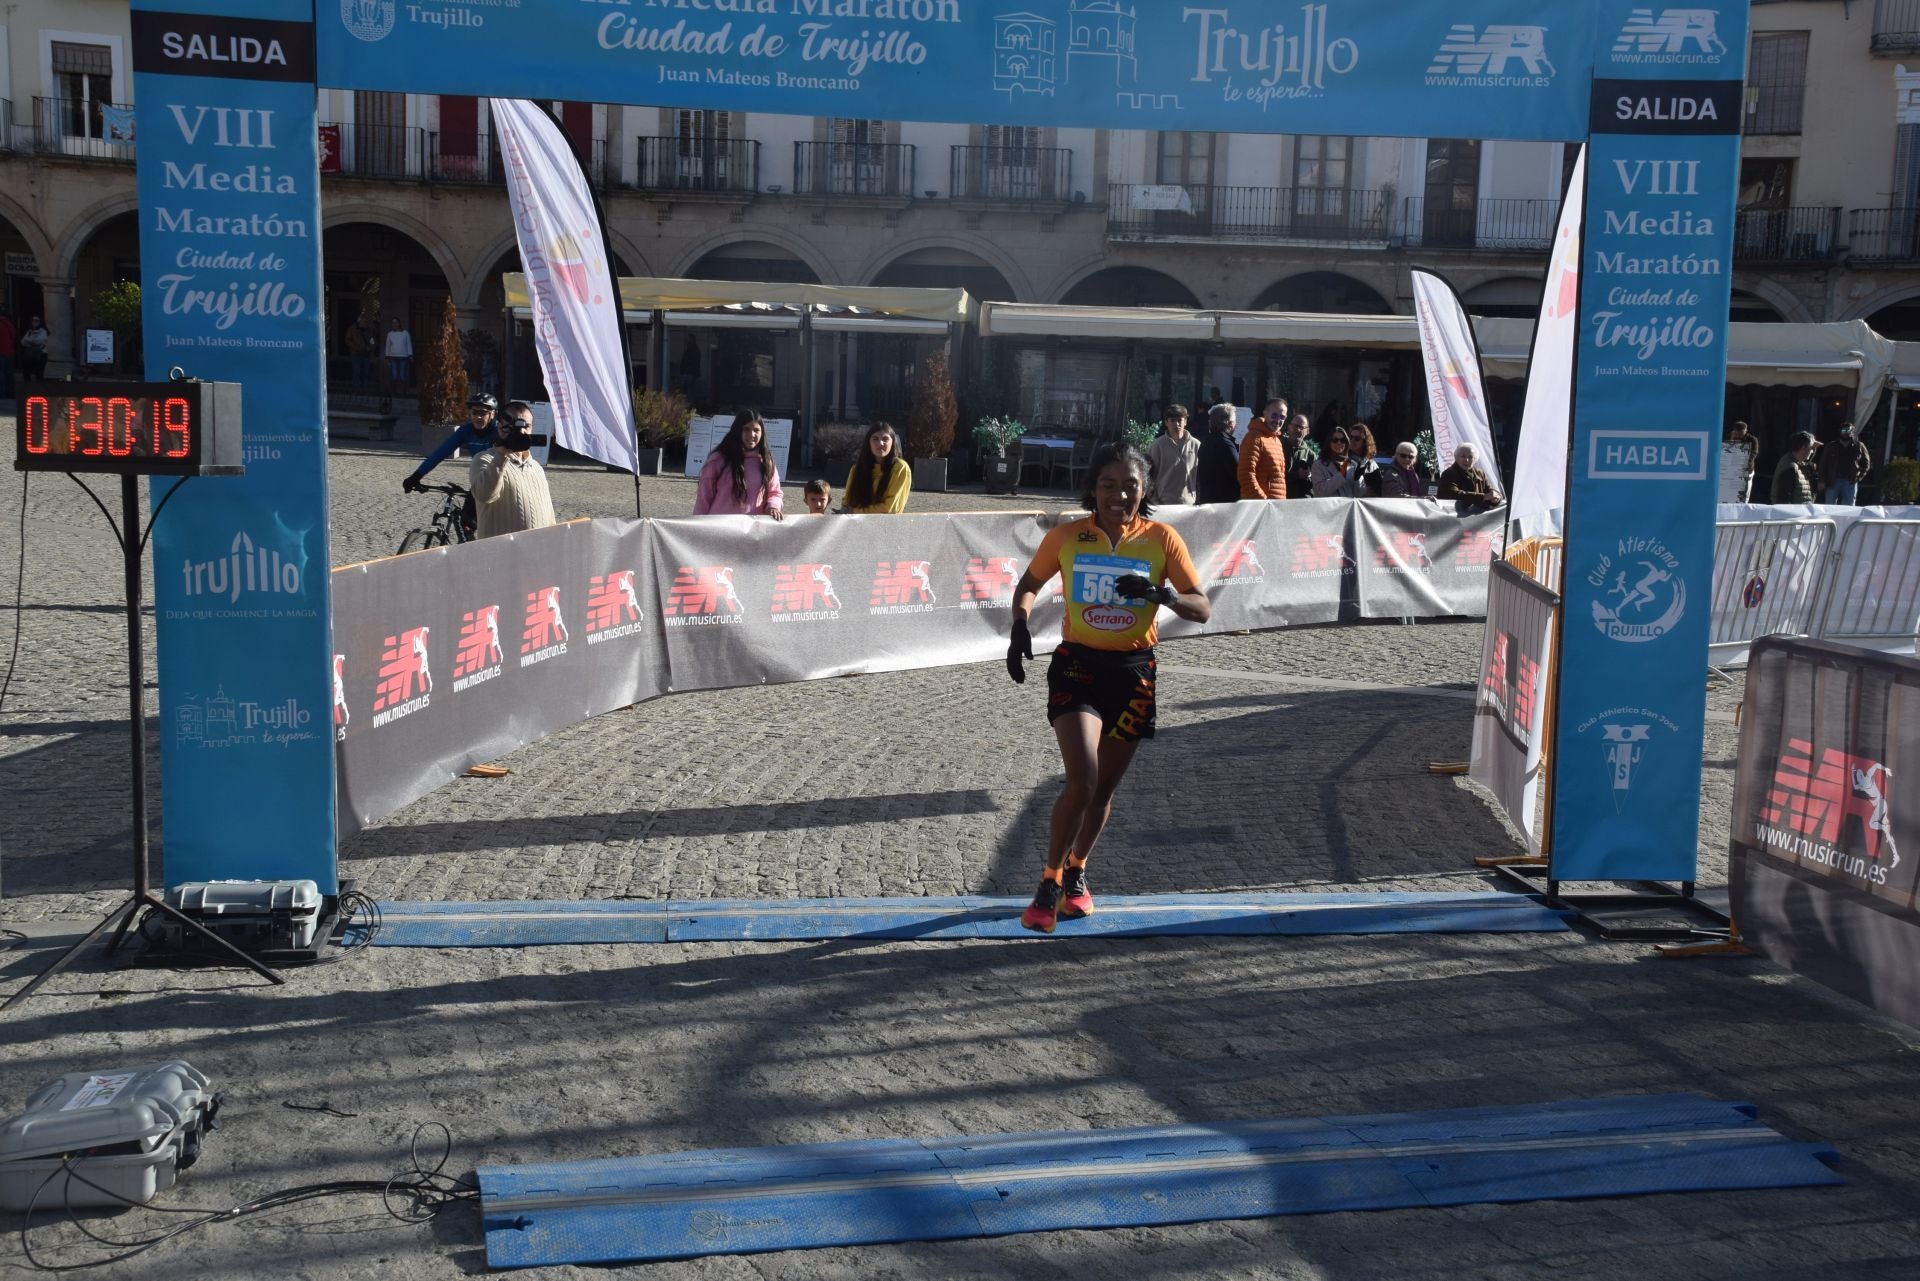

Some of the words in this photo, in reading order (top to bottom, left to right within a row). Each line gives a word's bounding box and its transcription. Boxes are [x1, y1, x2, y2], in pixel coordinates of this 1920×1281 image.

[406, 5, 484, 30] Trujillo
[162, 32, 287, 65] SALIDA
[597, 11, 733, 56] Ciudad
[739, 23, 788, 58] de
[798, 22, 927, 77] Trujillo
[1182, 3, 1359, 89] Trujillo
[1610, 53, 1720, 64] www.musicrun.es
[657, 65, 700, 83] Juan
[705, 67, 770, 87] Mateos
[775, 71, 860, 91] Broncano
[1223, 75, 1241, 102] te
[1424, 75, 1549, 87] www.musicrun.es
[1615, 96, 1718, 121] SALIDA
[166, 104, 276, 148] VIII
[162, 161, 297, 194] Media
[1612, 160, 1700, 195] VIII
[154, 206, 308, 237] Maratón
[1603, 210, 1714, 235] Media
[176, 247, 256, 270] Ciudad
[259, 253, 288, 271] de
[1595, 251, 1721, 275] Maratón
[156, 274, 306, 330] Trujillo
[1608, 286, 1674, 306] Ciudad
[1675, 289, 1700, 306] de
[165, 335, 194, 347] Juan
[197, 335, 242, 347] Mateos
[246, 337, 303, 348] Broncano
[1592, 311, 1714, 360] Trujillo
[1595, 365, 1619, 377] Juan
[1622, 366, 1659, 376] Mateos
[1661, 366, 1710, 376] Broncano
[25, 396, 189, 458] 01:30:19
[242, 432, 295, 442] ntamiento
[298, 432, 313, 442] de
[242, 445, 281, 463] jillo
[1605, 445, 1690, 466] HABLA
[182, 531, 299, 604] trujillo
[1587, 553, 1611, 587] Club
[1618, 536, 1679, 568] Atletismo
[165, 610, 189, 620] DEJA
[192, 610, 213, 620] QUE
[216, 609, 269, 618] COMIENCE
[272, 609, 284, 618] LA
[286, 609, 318, 618] MAGIA
[665, 612, 743, 627] www.musicrun.es
[771, 609, 839, 623] www.musicrun.es
[870, 602, 934, 615] www.musicrun.es
[1087, 610, 1135, 625] Serrano
[586, 621, 642, 646] www.musicrun.es
[1599, 618, 1664, 637] TRUJILLO
[520, 642, 568, 668] www.musicrun.es
[453, 664, 501, 693] www.musicrun.es
[239, 699, 311, 729] Trujillo
[372, 693, 430, 729] www.musicrun.es
[1577, 716, 1598, 733] Club
[1599, 706, 1640, 720] Athletico
[1641, 708, 1658, 719] San
[1659, 715, 1680, 732] José
[263, 730, 274, 743] te
[1756, 823, 1888, 885] www.musicrun.es
